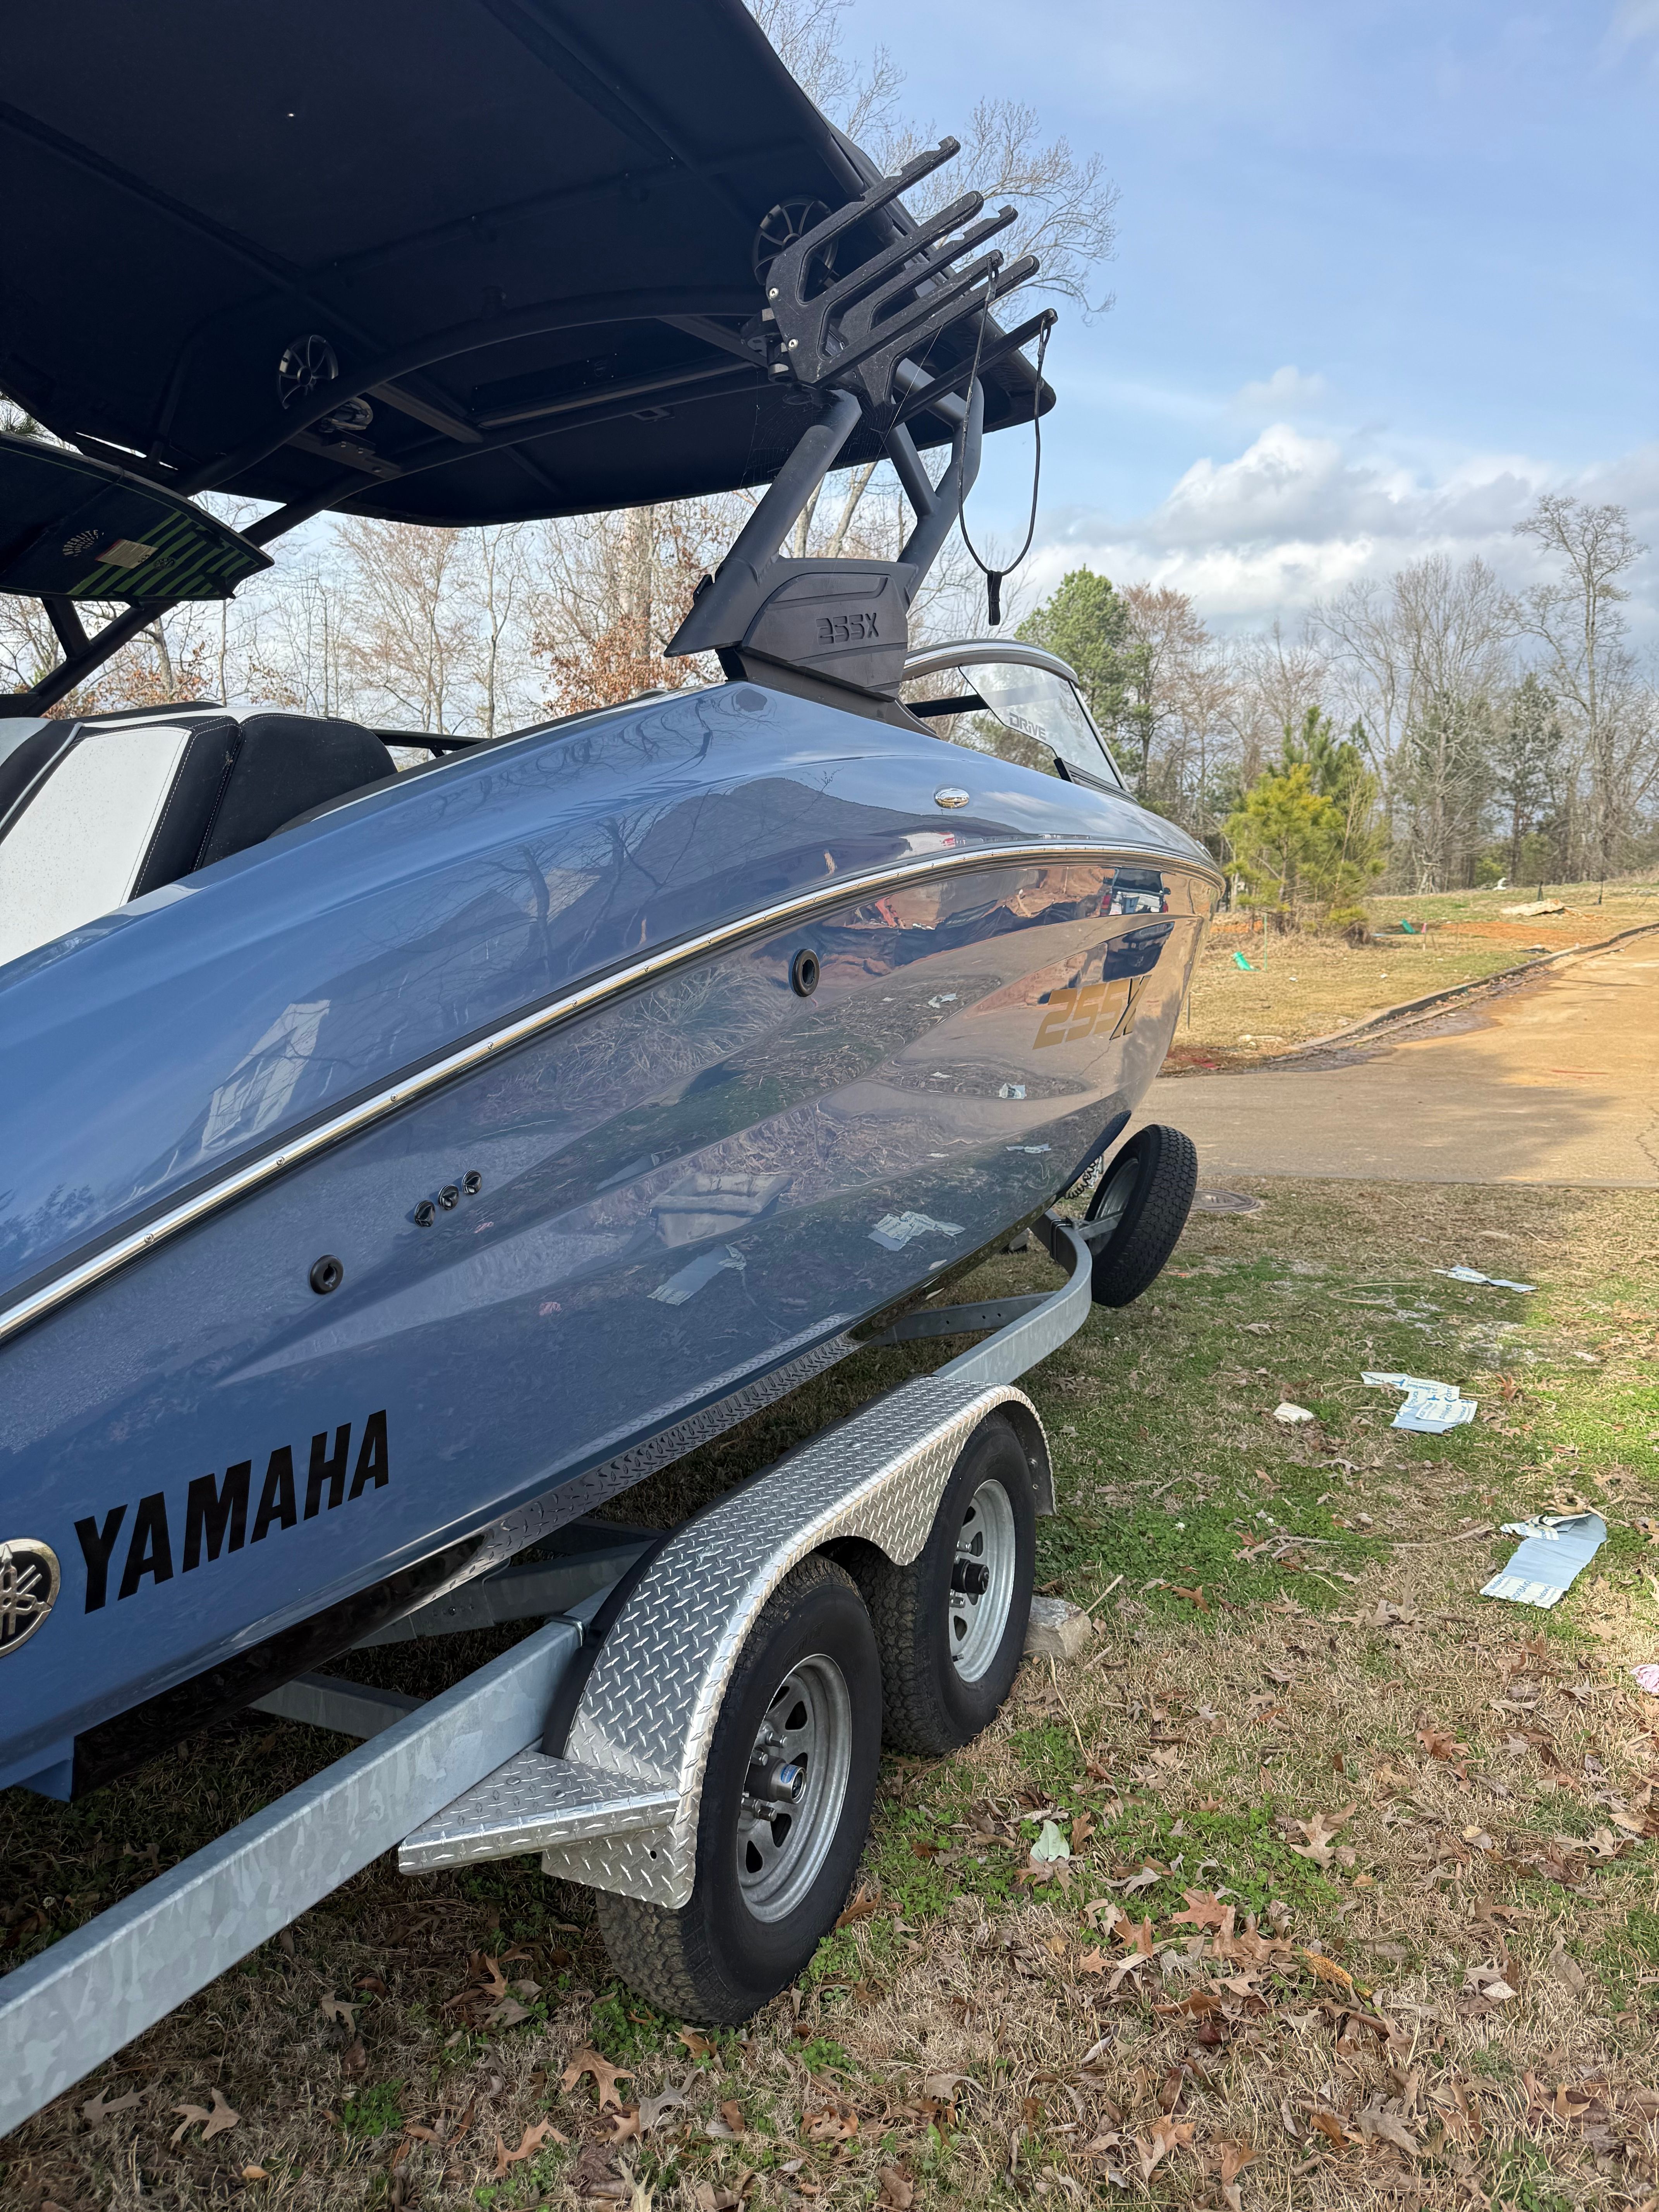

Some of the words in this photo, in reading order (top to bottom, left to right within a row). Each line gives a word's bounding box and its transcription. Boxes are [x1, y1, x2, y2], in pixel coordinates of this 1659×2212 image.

[62, 529, 98, 556] HYPERLITE
[816, 613, 879, 646] 255X
[1032, 975, 1152, 1050] 255X
[74, 1409, 389, 1614] YAMAHA
